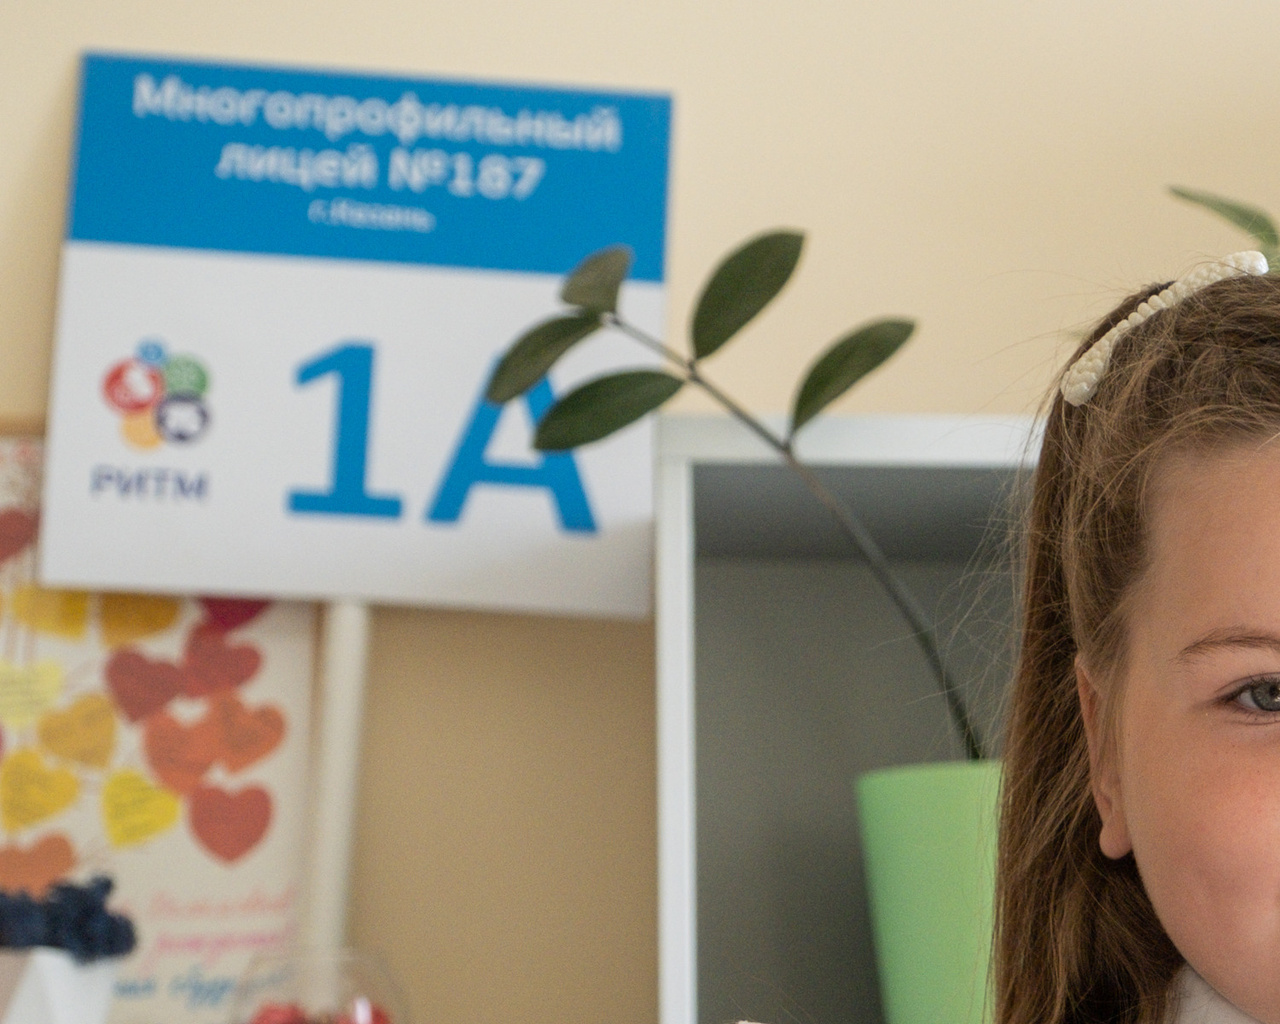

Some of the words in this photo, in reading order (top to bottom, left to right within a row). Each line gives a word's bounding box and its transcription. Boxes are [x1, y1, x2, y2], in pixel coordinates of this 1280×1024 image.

[134, 74, 622, 153] Многопрофильный
[215, 143, 378, 192] лицей
[91, 464, 211, 501] РИТМ
